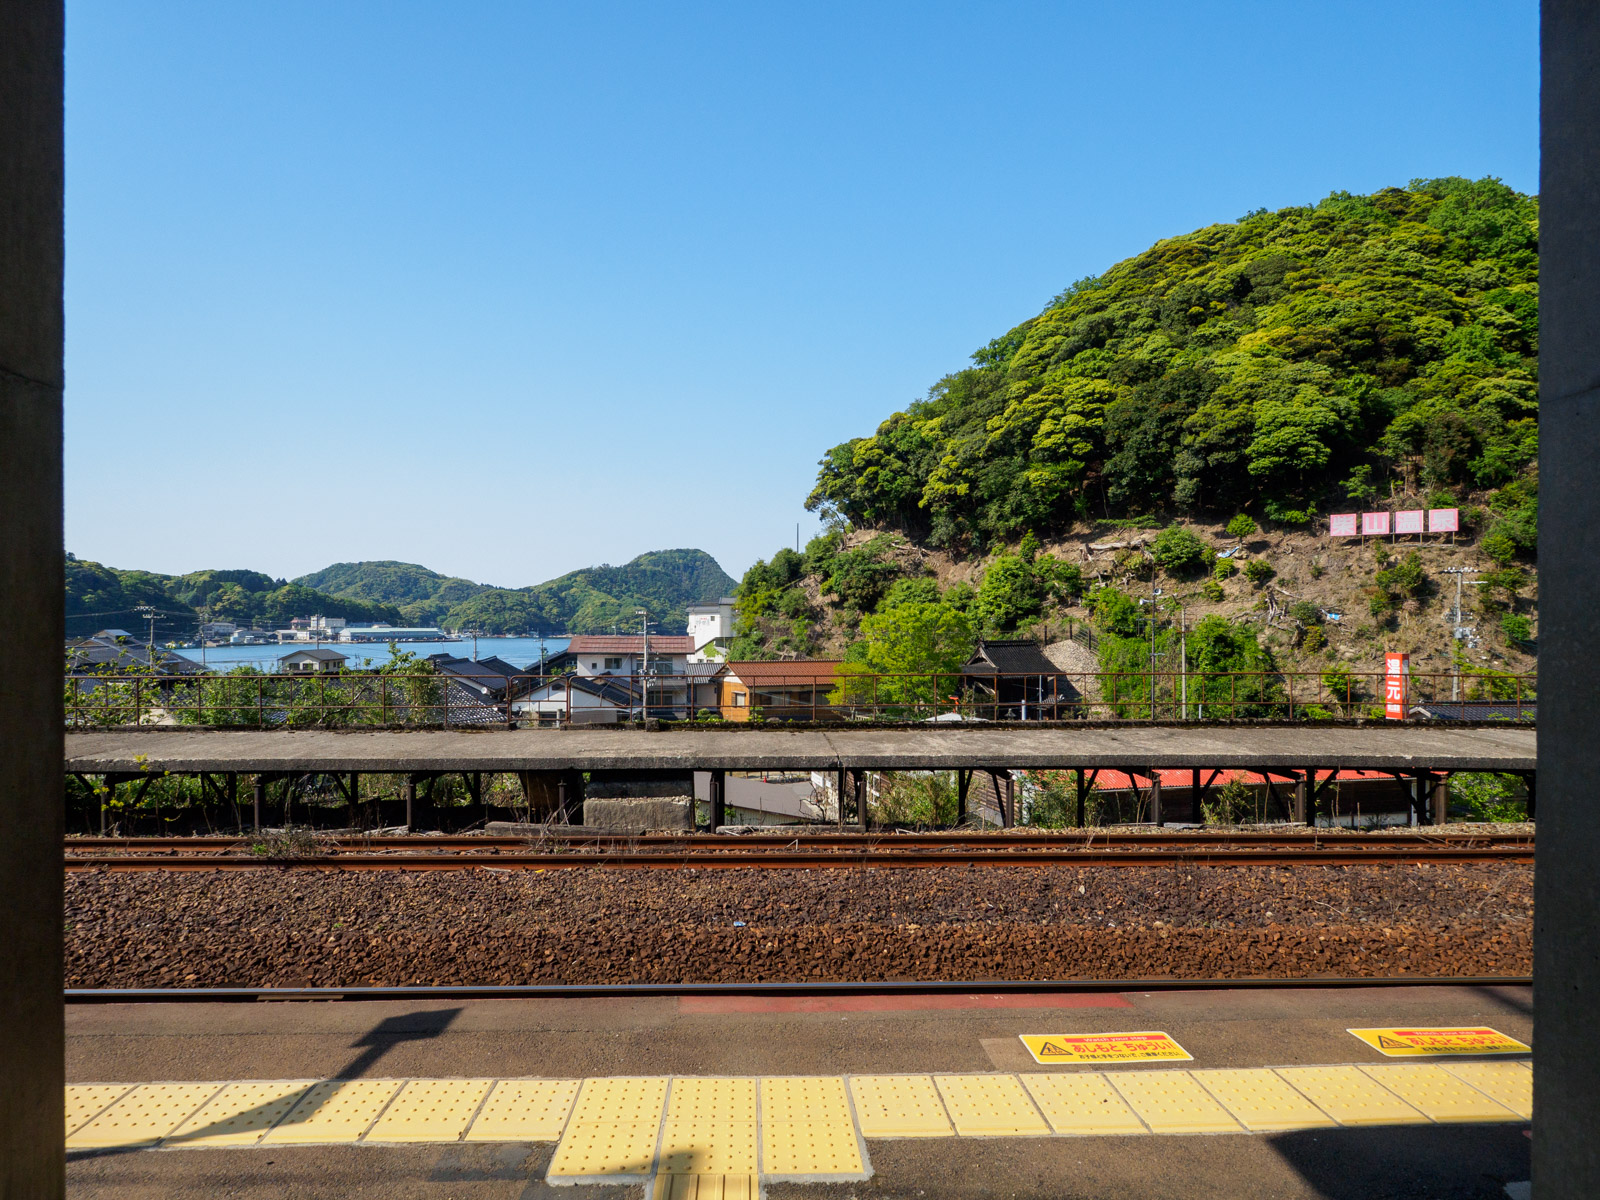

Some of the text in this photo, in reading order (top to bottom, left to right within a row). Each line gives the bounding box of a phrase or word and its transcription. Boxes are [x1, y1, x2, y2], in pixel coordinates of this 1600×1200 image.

[1332, 511, 1456, 535] 柴山温泉
[1071, 1043, 1123, 1053] あしもと
